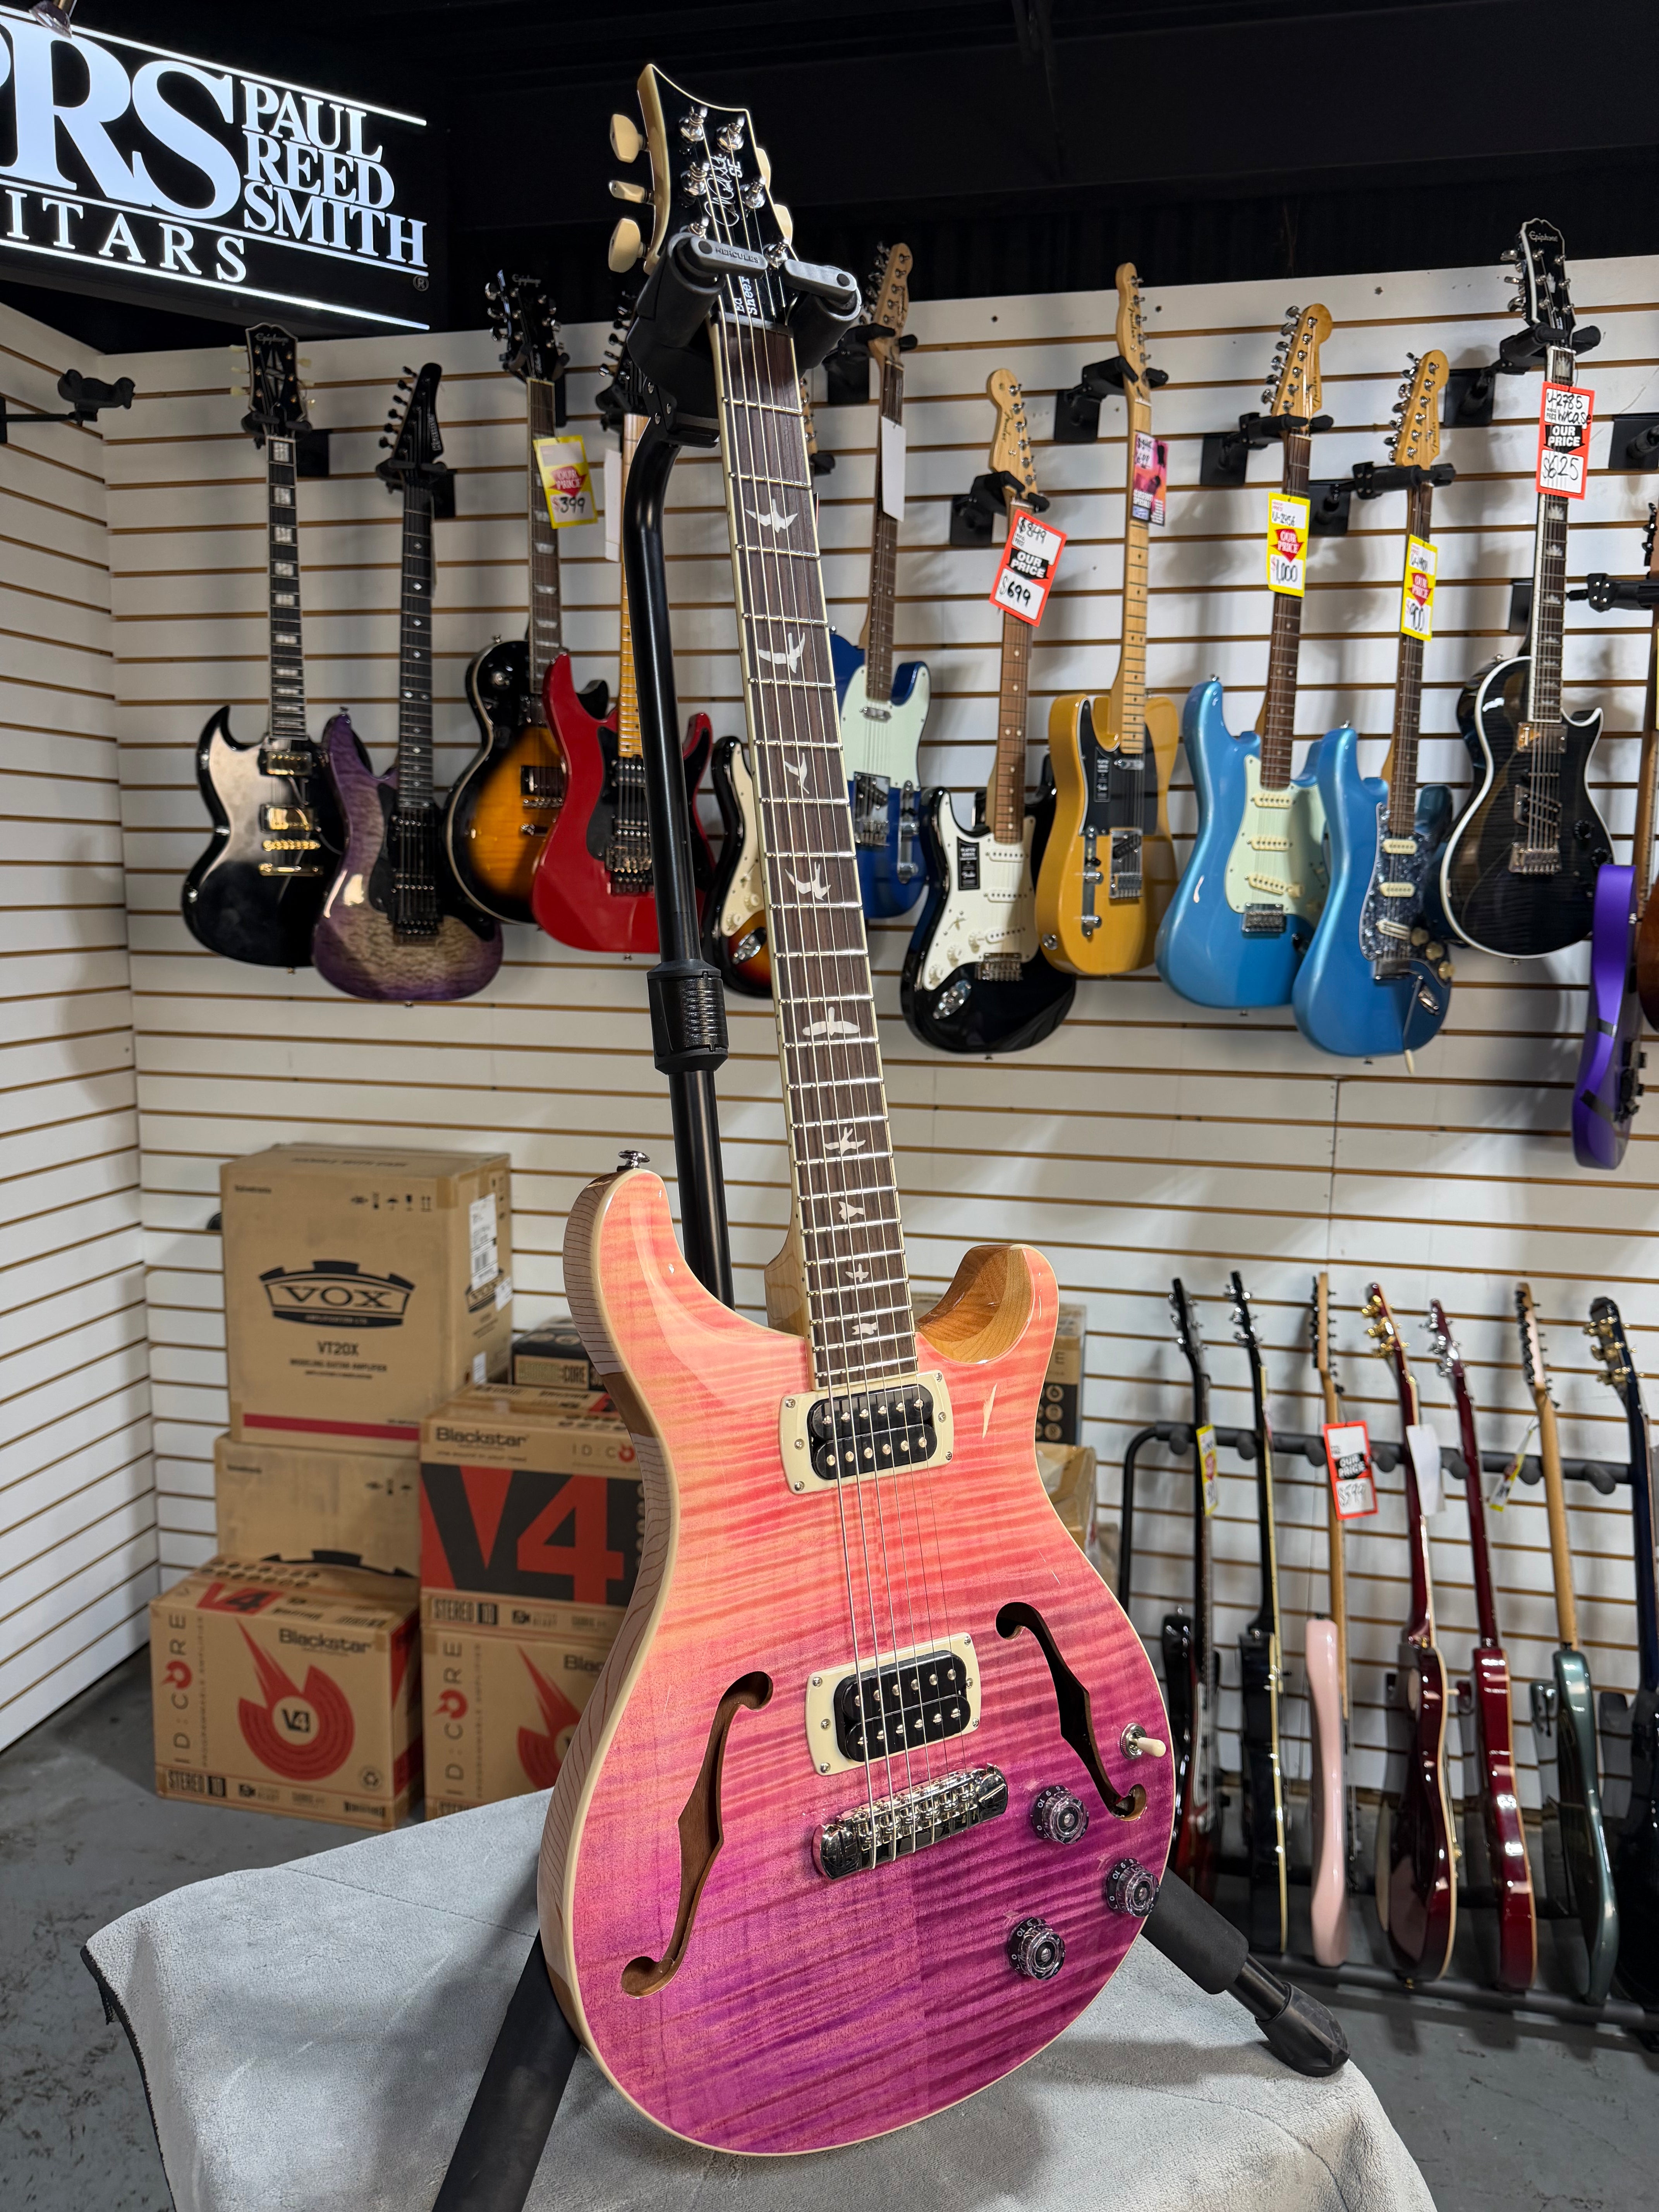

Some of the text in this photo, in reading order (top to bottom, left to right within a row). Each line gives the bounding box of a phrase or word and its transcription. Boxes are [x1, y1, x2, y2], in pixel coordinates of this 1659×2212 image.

[0, 15, 241, 220] RS
[240, 79, 383, 163] PAUL
[242, 129, 395, 210] REED
[727, 159, 743, 178] SE
[243, 180, 429, 268] SMITH
[715, 247, 759, 264] HERCULES
[1552, 425, 1576, 437] OUR
[1547, 436, 1581, 447] PRICE
[556, 469, 579, 481] OUR
[1543, 454, 1580, 481] $625
[555, 477, 581, 490] PRICE
[551, 496, 586, 514] $399
[1279, 530, 1297, 543] OUR
[1278, 541, 1299, 554] PRICE
[1017, 551, 1043, 568] OUR
[1010, 558, 1046, 579] PRICE
[1414, 574, 1428, 588] OUR
[1000, 576, 1031, 608] $699
[1412, 585, 1430, 600] PRICE
[279, 1284, 392, 1310] VOX
[316, 1340, 360, 1357] VT20X
[436, 1426, 527, 1448] Blackstar
[1339, 1453, 1361, 1468] OUR
[1338, 1461, 1366, 1479] PRICE
[278, 1627, 371, 1654] Blackstar
[1037, 1799, 1045, 1808] 10
[1112, 1870, 1120, 1880] 10
[1017, 1927, 1025, 1937] 10
